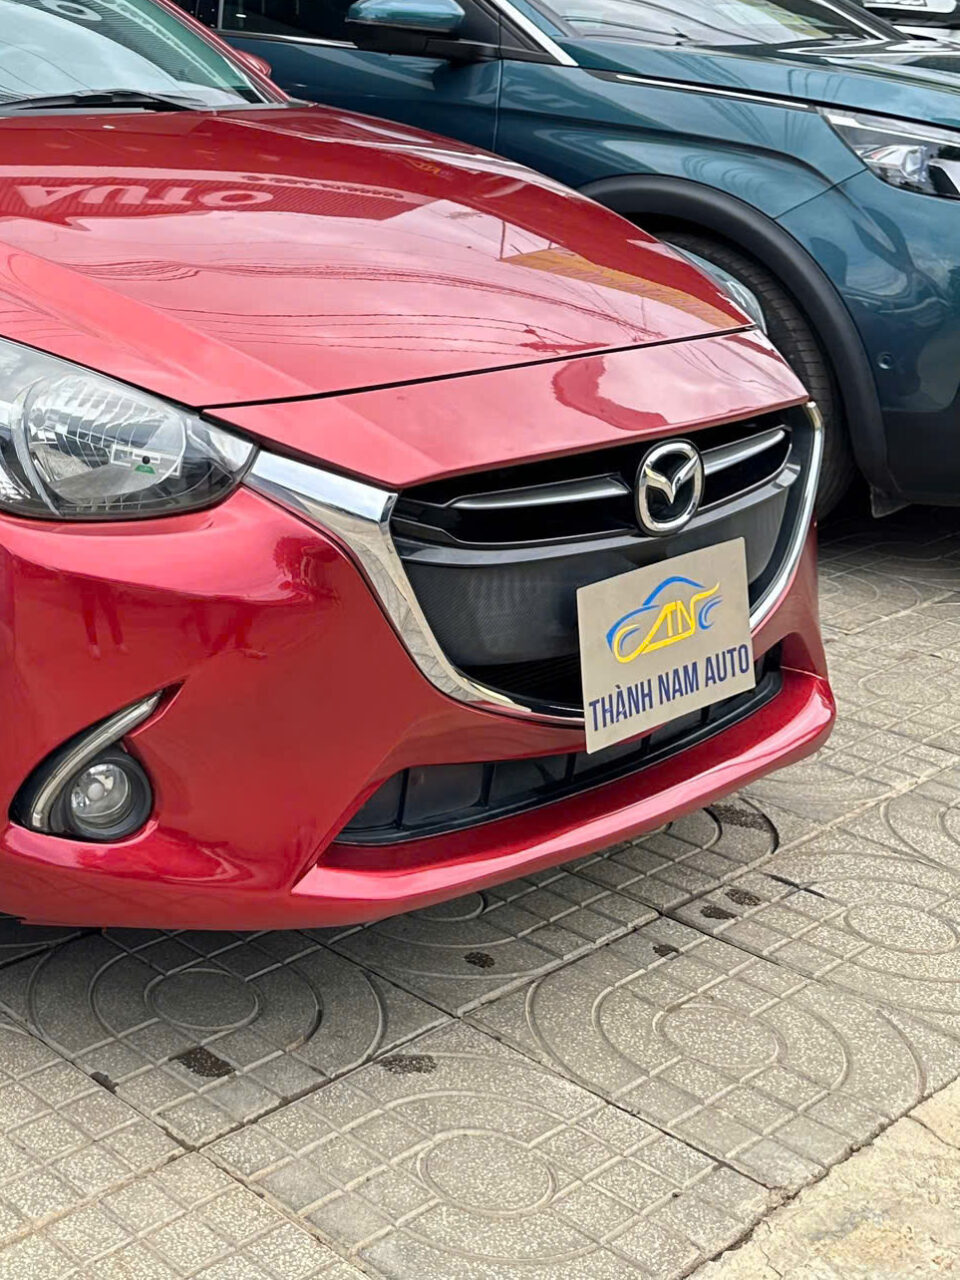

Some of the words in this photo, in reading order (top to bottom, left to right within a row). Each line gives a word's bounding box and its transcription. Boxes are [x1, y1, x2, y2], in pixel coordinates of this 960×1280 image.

[589, 678, 653, 732] THÀNH
[658, 661, 699, 705] NAM
[705, 643, 749, 687] AUTO
